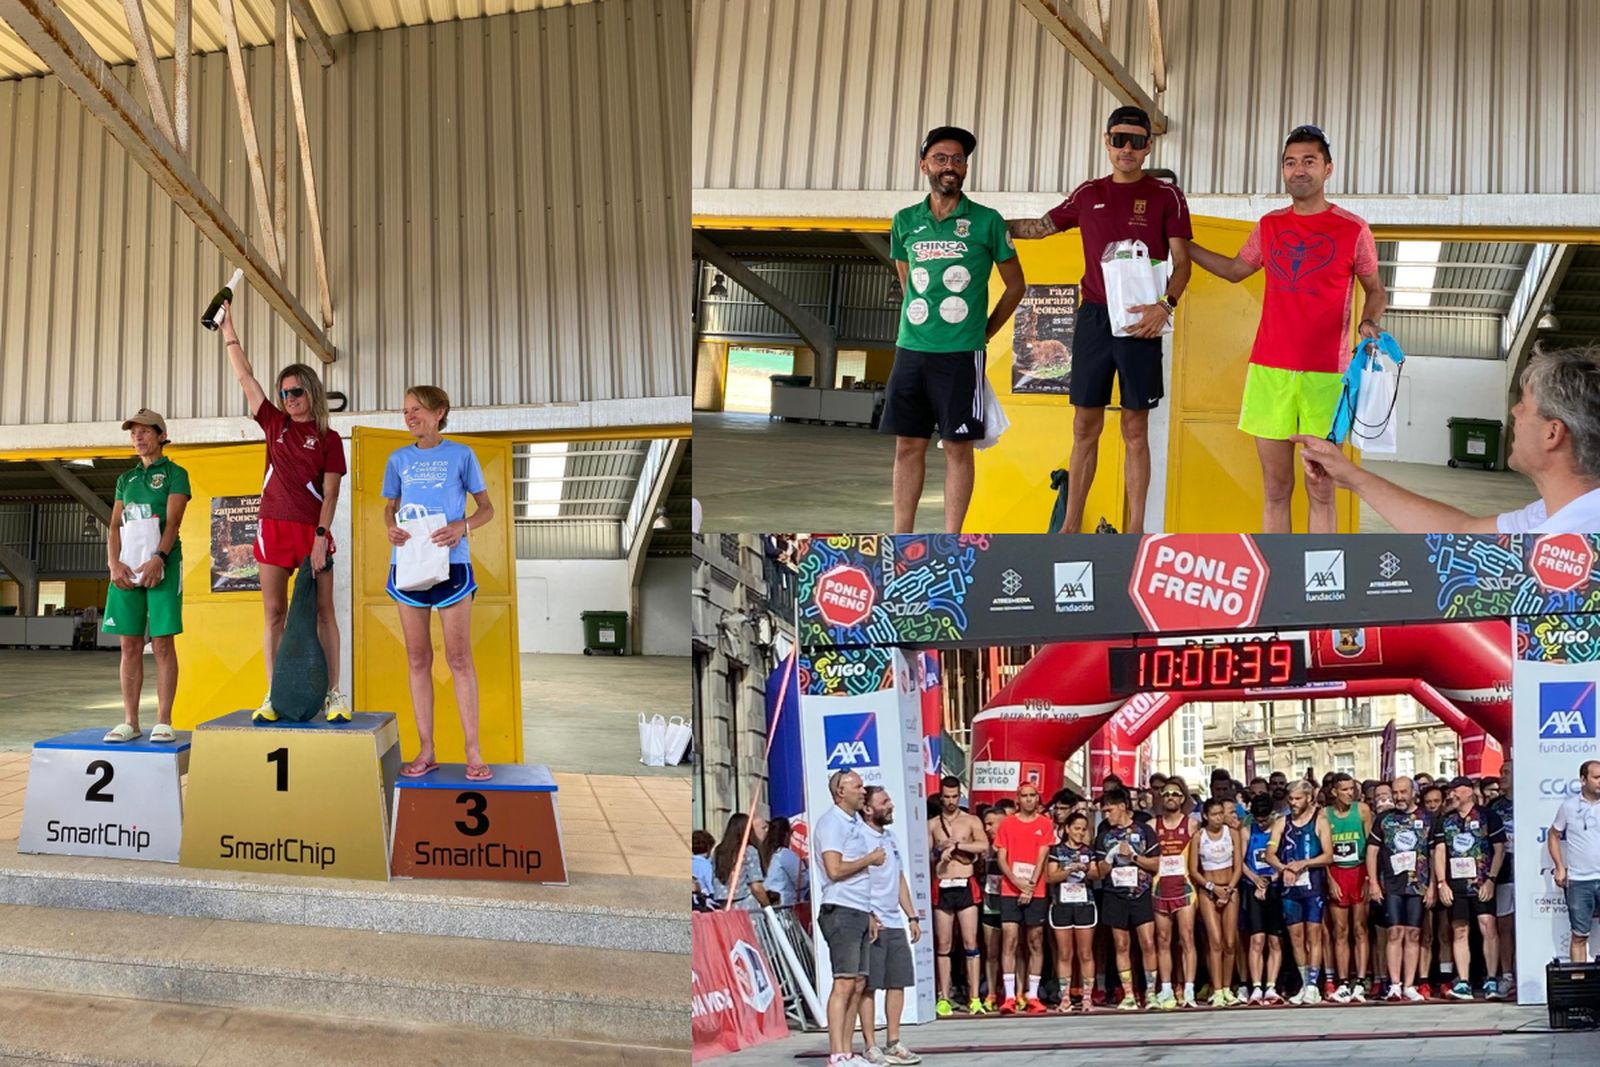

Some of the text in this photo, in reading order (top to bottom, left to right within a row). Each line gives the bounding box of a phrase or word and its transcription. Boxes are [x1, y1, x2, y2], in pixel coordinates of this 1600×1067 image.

[913, 241, 967, 251] CHINCA
[1049, 288, 1074, 296] raza
[1033, 305, 1073, 314] leonesa
[226, 514, 258, 522] leones
[1541, 543, 1586, 564] PONLE
[1155, 545, 1251, 590] PONLE
[1538, 556, 1583, 577] FRENO
[1305, 571, 1337, 587] AXA
[825, 580, 868, 601] PONLE
[1056, 582, 1086, 598] AXA
[1148, 572, 1243, 615] FRENO
[1305, 592, 1345, 602] fundación
[823, 592, 865, 612] FRENO
[1056, 603, 1095, 613] fundación
[1546, 630, 1589, 644] VIGO
[826, 663, 866, 677] VIGO
[1139, 646, 1291, 687] 10:00:39
[1035, 712, 1049, 720] de
[1539, 710, 1587, 734] AXA
[827, 741, 871, 765] AXA
[1539, 742, 1597, 753] fundación
[267, 748, 288, 792] 1
[975, 767, 1015, 776] CONCELLO
[85, 760, 115, 803] 2
[454, 792, 490, 836] 3
[47, 820, 150, 852] SmartChip
[220, 835, 335, 870] SmartChip
[415, 841, 541, 874] SmartChip
